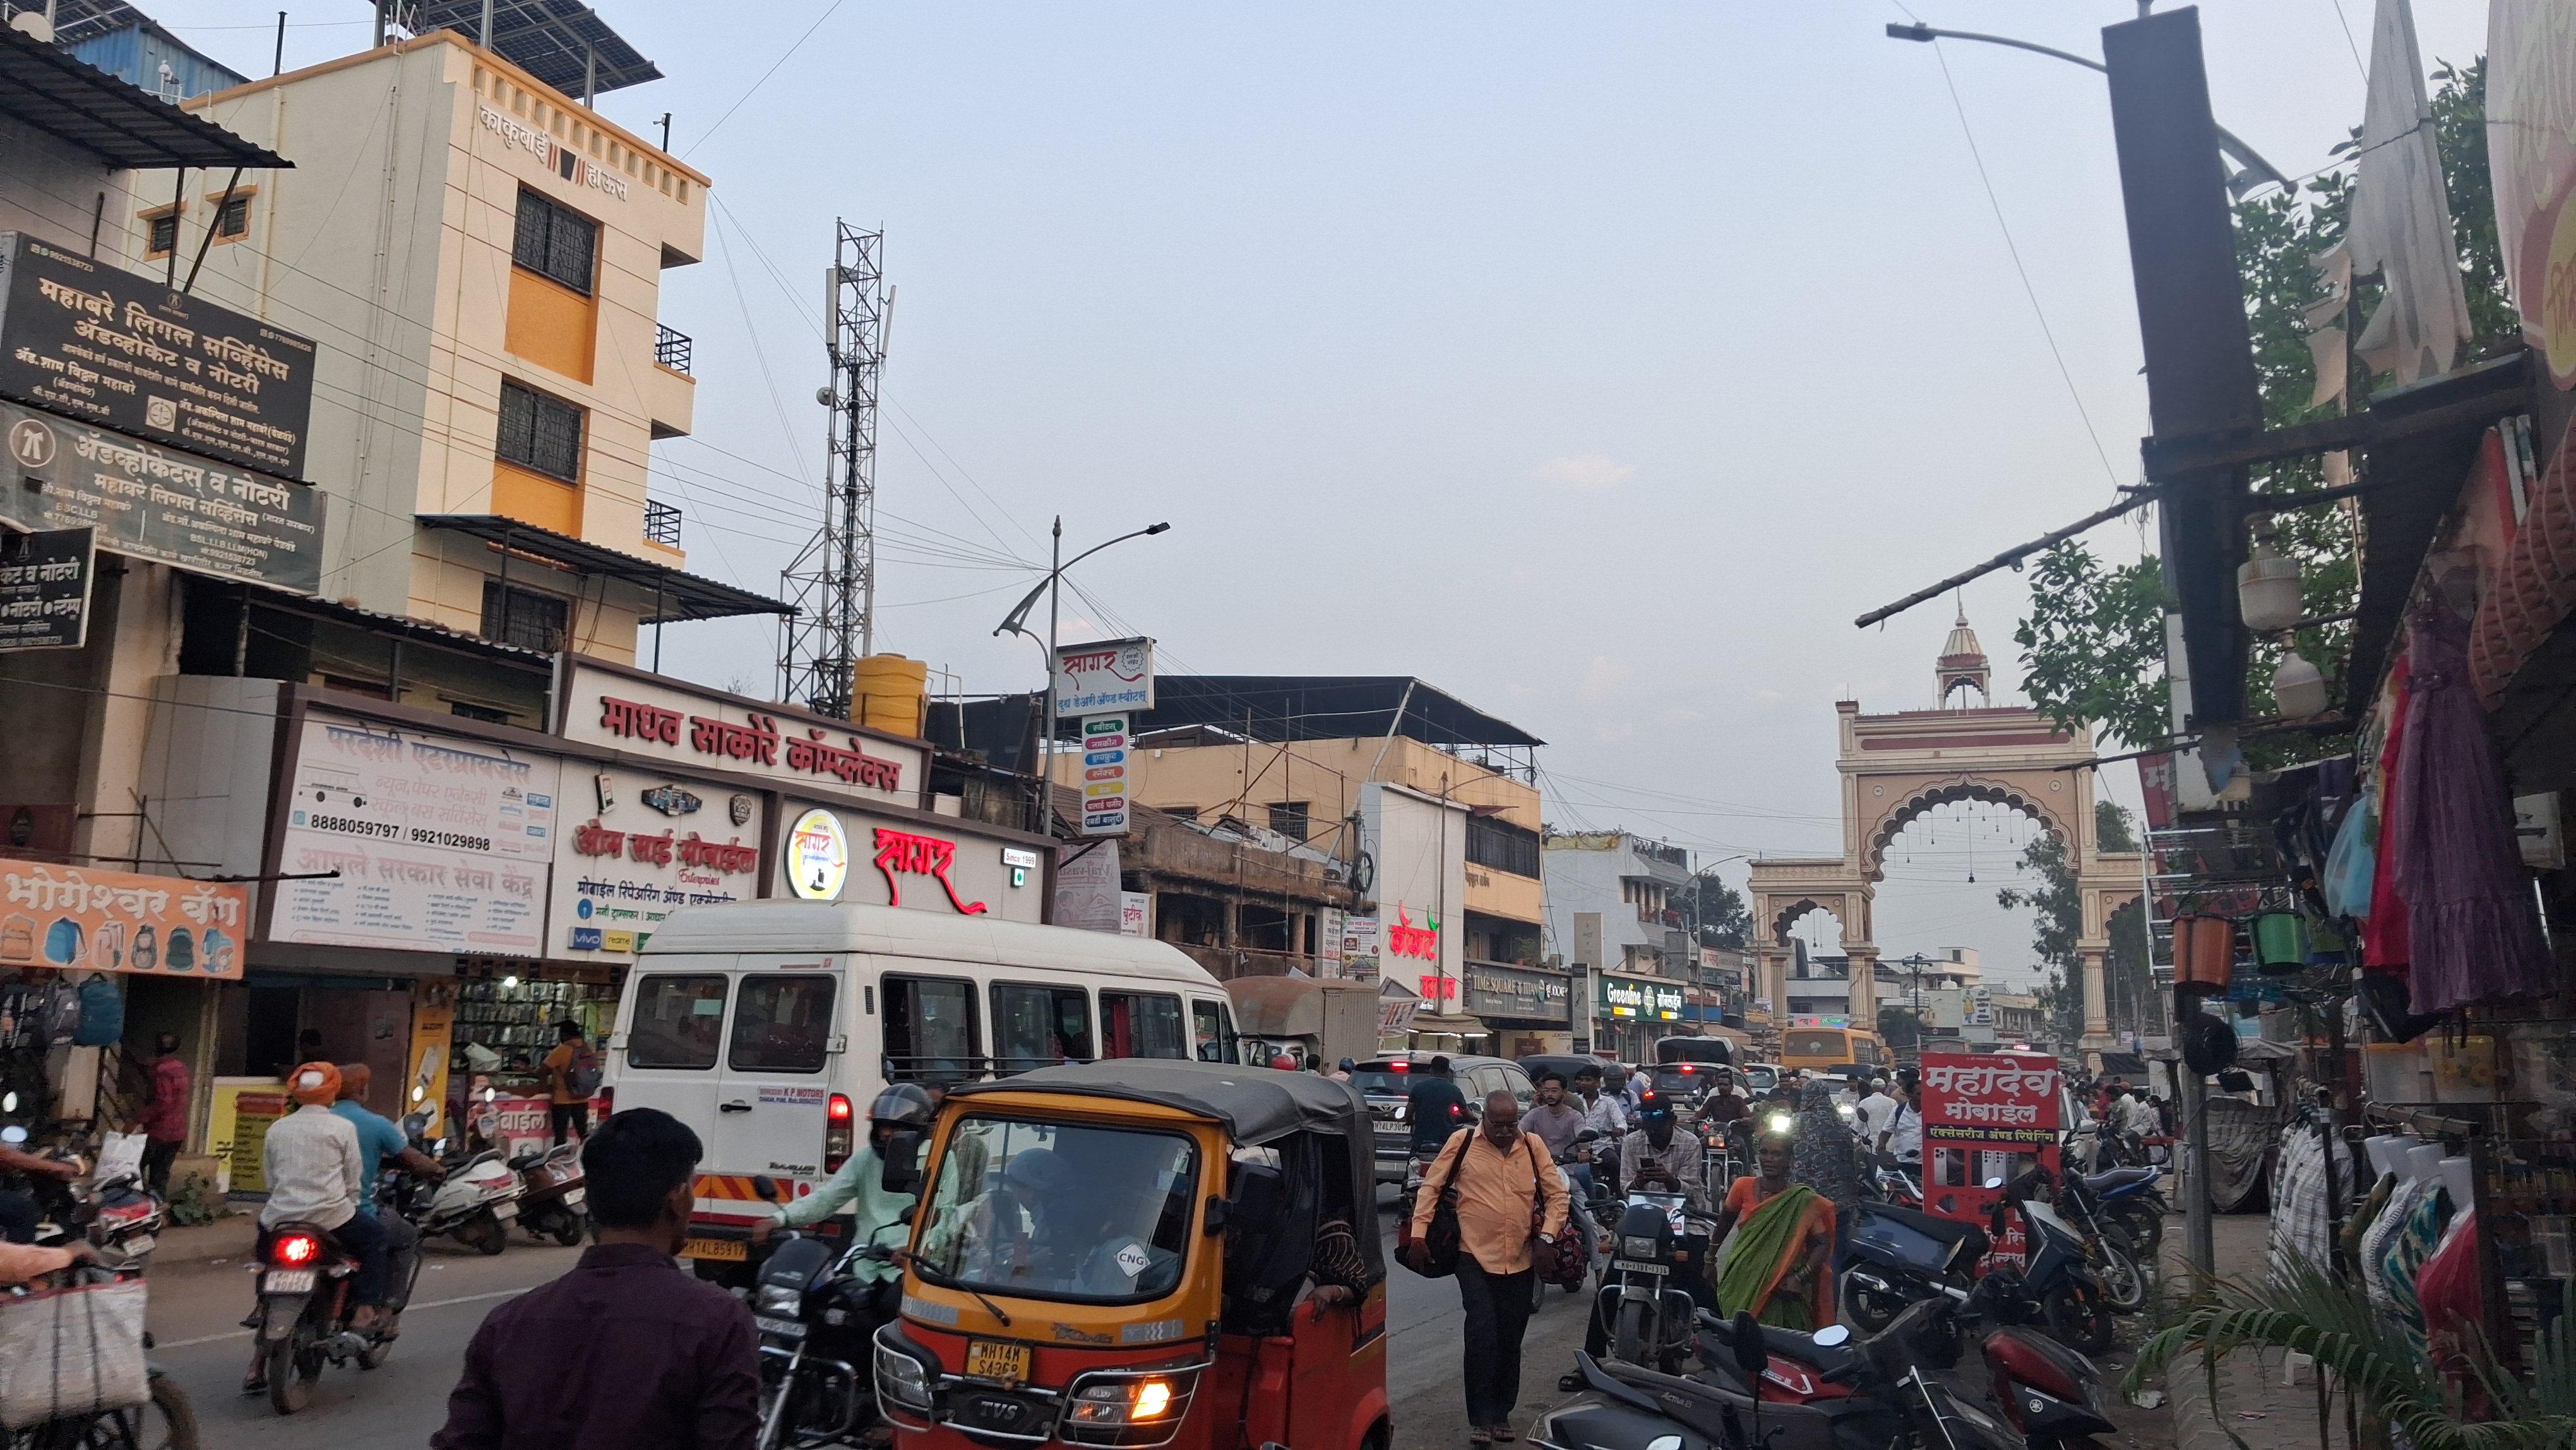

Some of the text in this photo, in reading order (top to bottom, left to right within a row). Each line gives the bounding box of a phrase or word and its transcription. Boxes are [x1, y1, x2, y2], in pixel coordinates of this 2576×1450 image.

[39, 276, 116, 321] महाबरे
[123, 301, 195, 348] लिगल
[184, 356, 202, 375] व
[208, 361, 260, 395] नोटरी
[94, 473, 148, 500] महाबरे
[209, 471, 228, 494] व
[232, 472, 290, 511] नोटरी
[1063, 651, 1147, 691] सागर
[1073, 693, 1096, 707] डेअरी
[600, 695, 903, 793] माधव साकोरे कॉम्प्लेक्स
[1091, 738, 1118, 748] नमकीन
[311, 814, 400, 839] 8888059797
[411, 827, 491, 851] 9921029898
[794, 830, 847, 868] सागर
[628, 828, 675, 869] साई
[676, 830, 758, 876] मोबाईल
[1006, 851, 1021, 863] Since
[377, 856, 447, 893] सरकार
[455, 858, 495, 892] सेवा
[577, 875, 616, 899] मोबाईल
[873, 827, 987, 915] सागर
[4, 866, 170, 922] भोगेश्वर
[181, 884, 241, 927] बॅग
[1474, 975, 1491, 991] TIME
[1491, 978, 1516, 994] SQUARE
[1523, 982, 1538, 996] TITAN
[1607, 982, 1642, 1005] Greenline
[1926, 1058, 2058, 1098] महादेव
[1944, 1096, 2038, 1126] मोबाईल
[1118, 1252, 1146, 1266] CNG
[981, 1400, 1018, 1420] TVS
